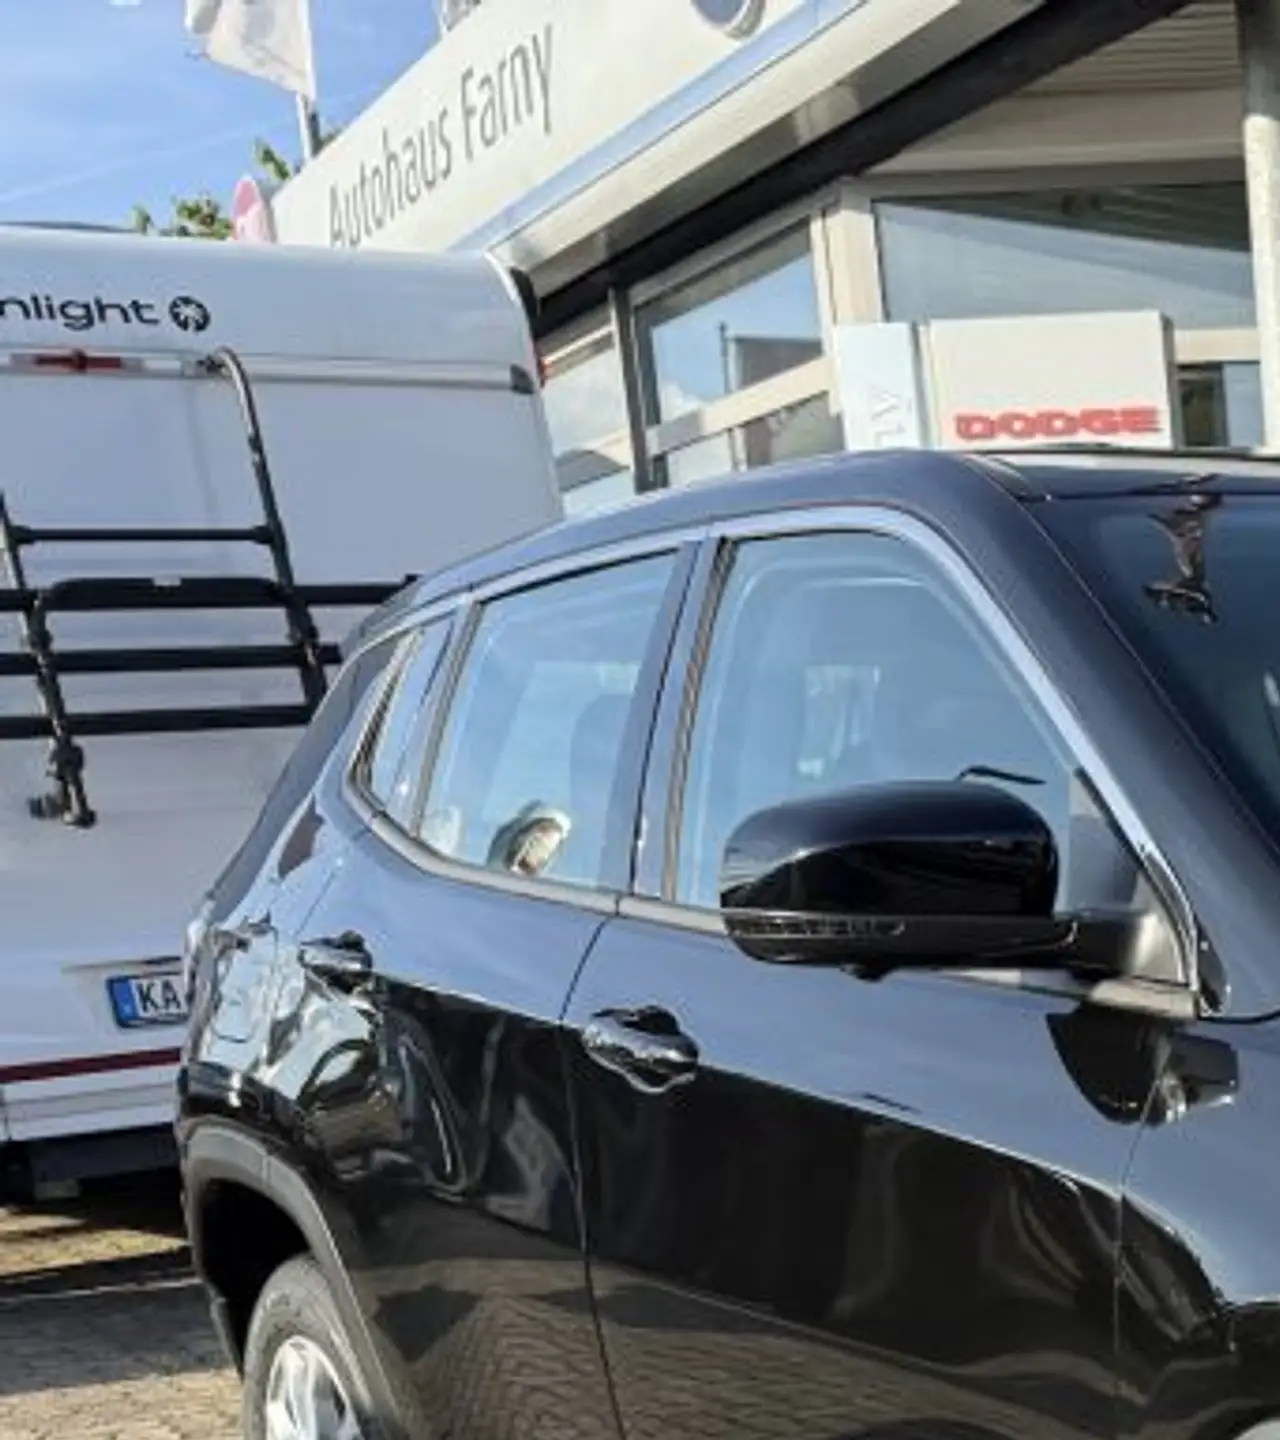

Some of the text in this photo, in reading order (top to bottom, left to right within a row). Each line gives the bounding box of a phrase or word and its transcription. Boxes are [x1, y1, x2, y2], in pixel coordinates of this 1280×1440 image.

[330, 23, 554, 249] Autohaus Farny
[0, 292, 161, 332] nlight
[954, 406, 1163, 441] DODGE
[136, 979, 183, 1014] KA
